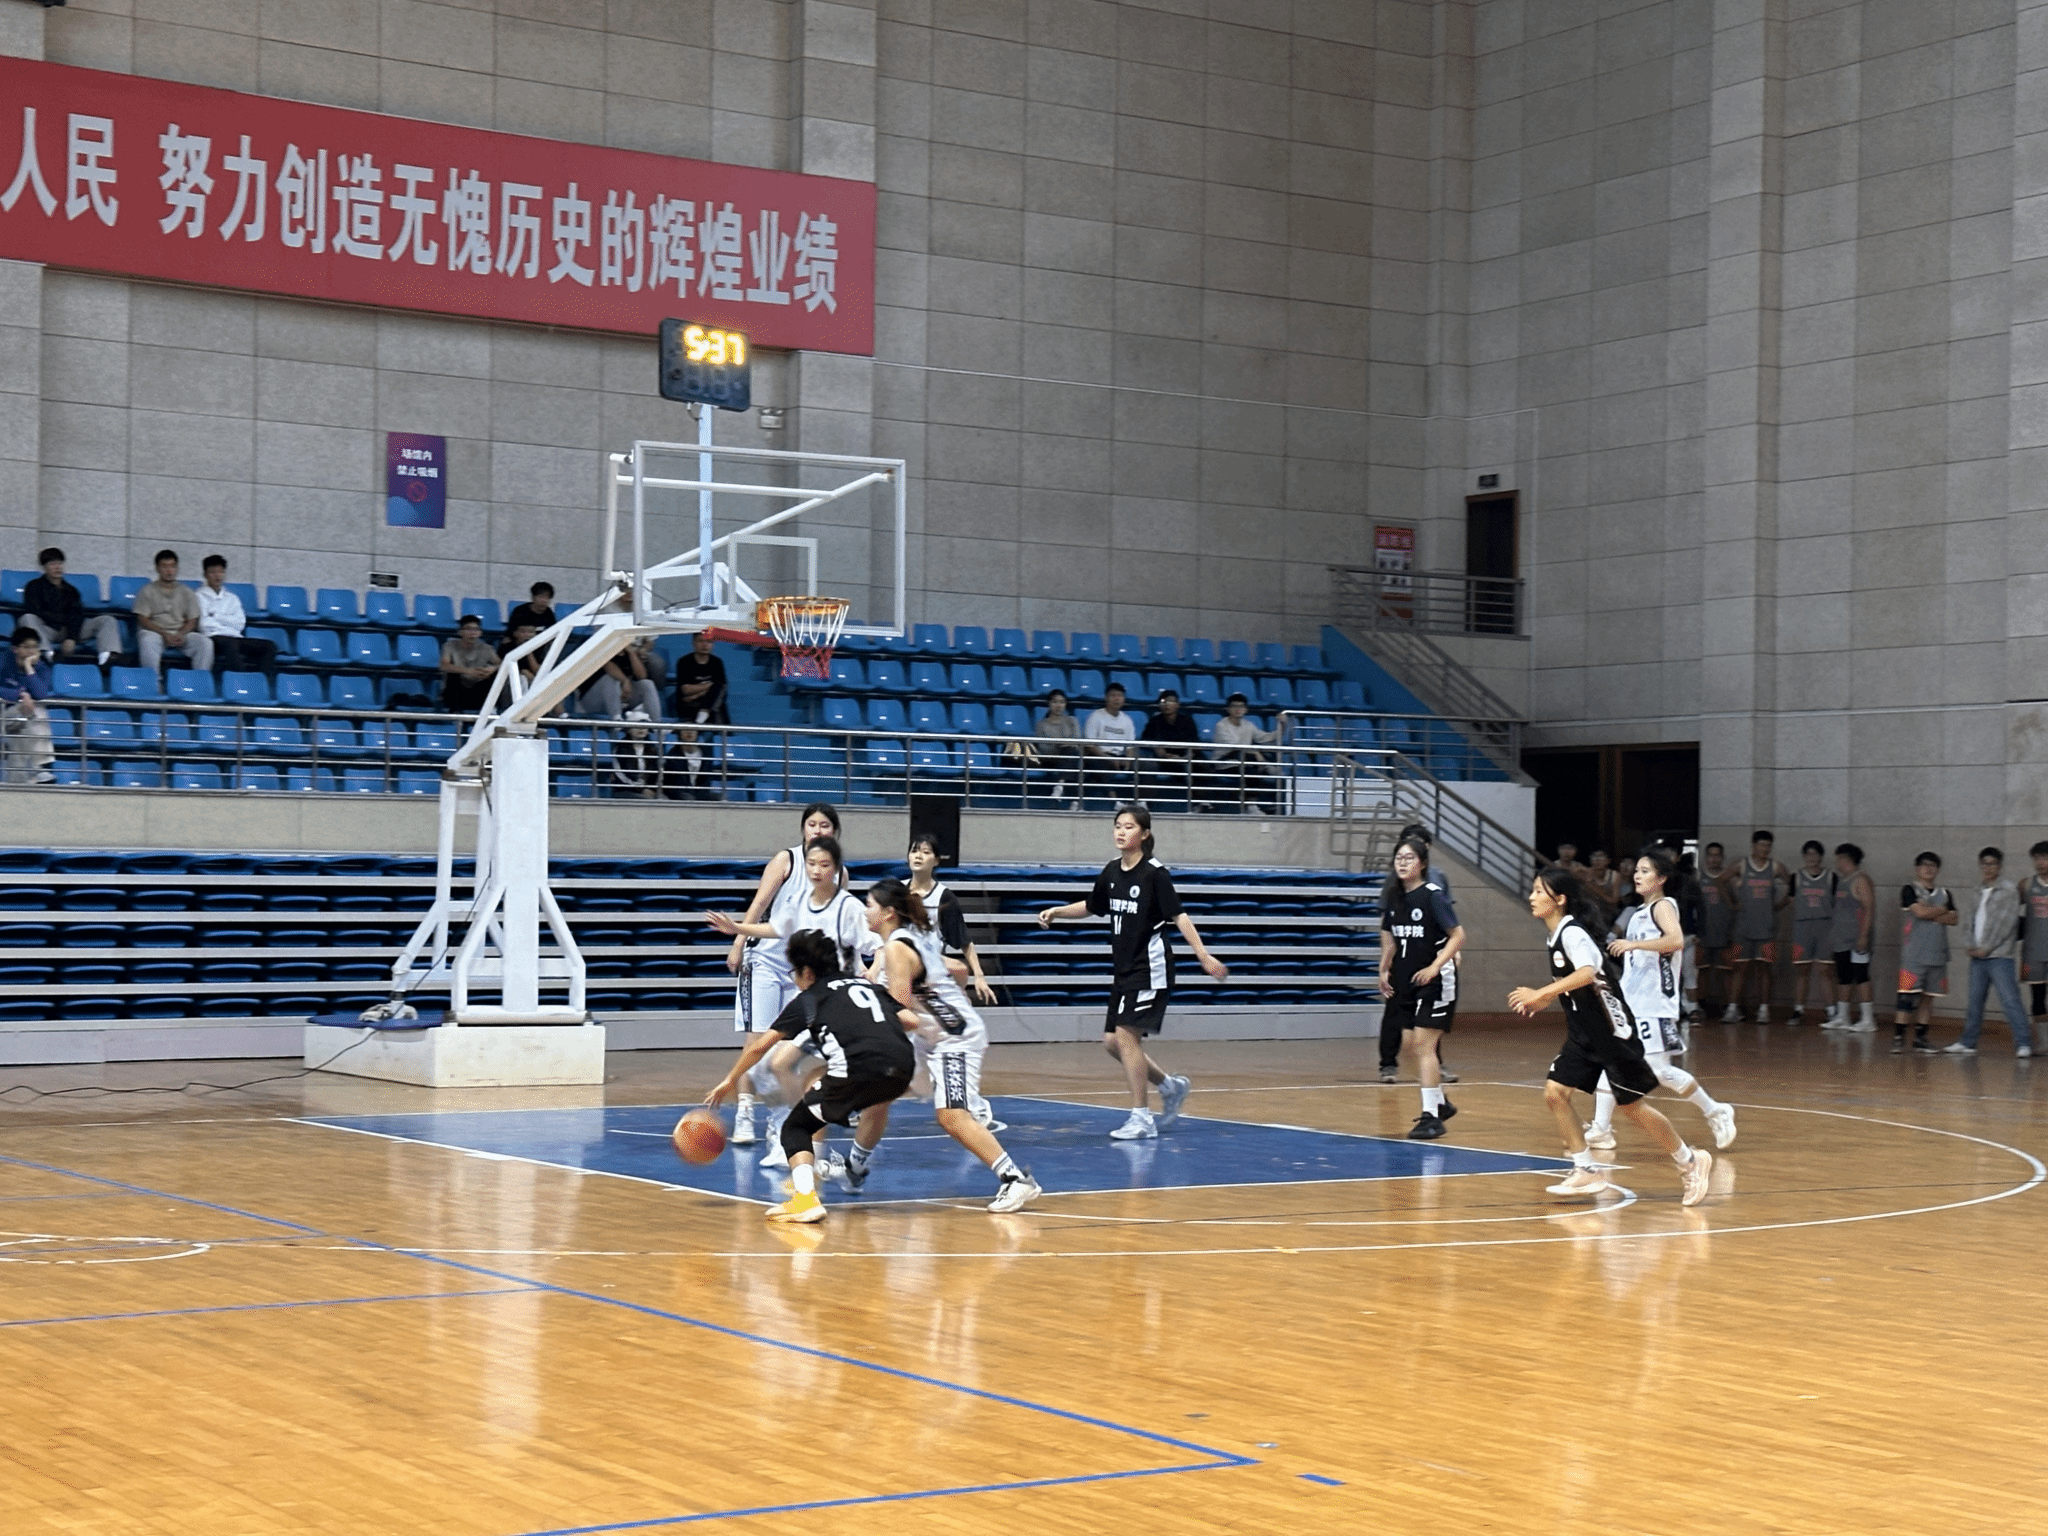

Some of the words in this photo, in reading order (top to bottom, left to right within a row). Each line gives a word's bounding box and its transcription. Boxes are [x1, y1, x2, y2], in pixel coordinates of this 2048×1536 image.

[1, 106, 119, 227] 人民
[158, 123, 839, 315] 努力创造无愧历史的辉煌业绩
[848, 985, 886, 1023] 9
[1640, 1020, 1652, 1039] 2
